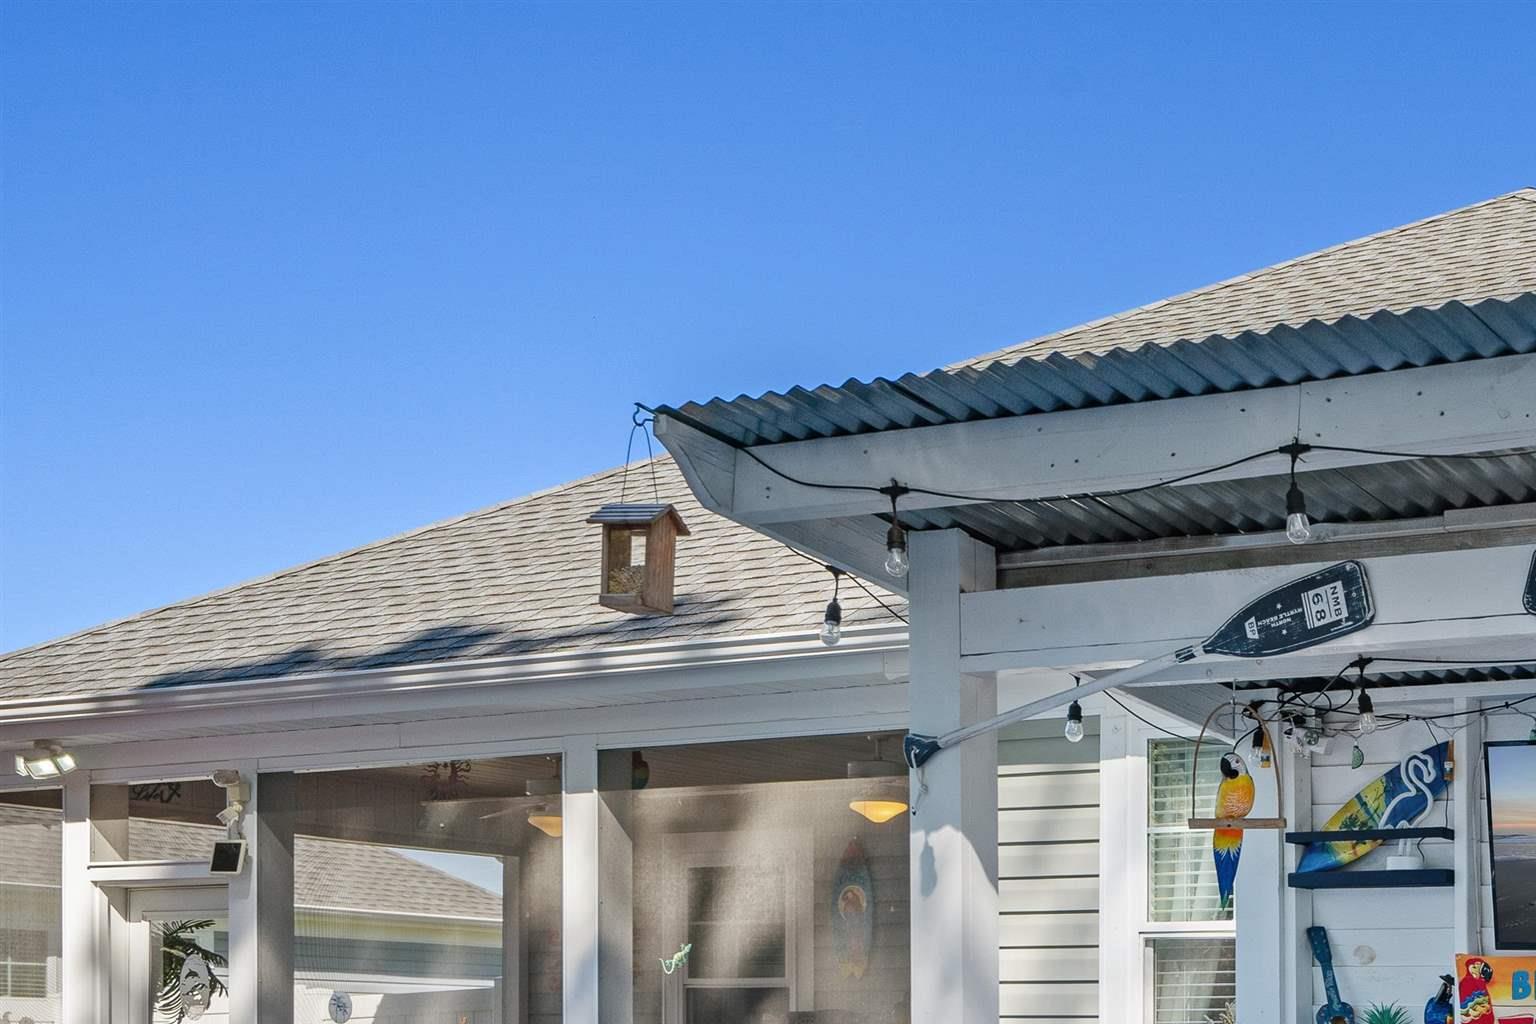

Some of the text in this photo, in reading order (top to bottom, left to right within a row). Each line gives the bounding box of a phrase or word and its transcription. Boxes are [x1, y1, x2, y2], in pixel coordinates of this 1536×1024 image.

[1312, 593, 1327, 622] 68
[1330, 585, 1343, 617] NMB
[1247, 622, 1257, 639] BP
